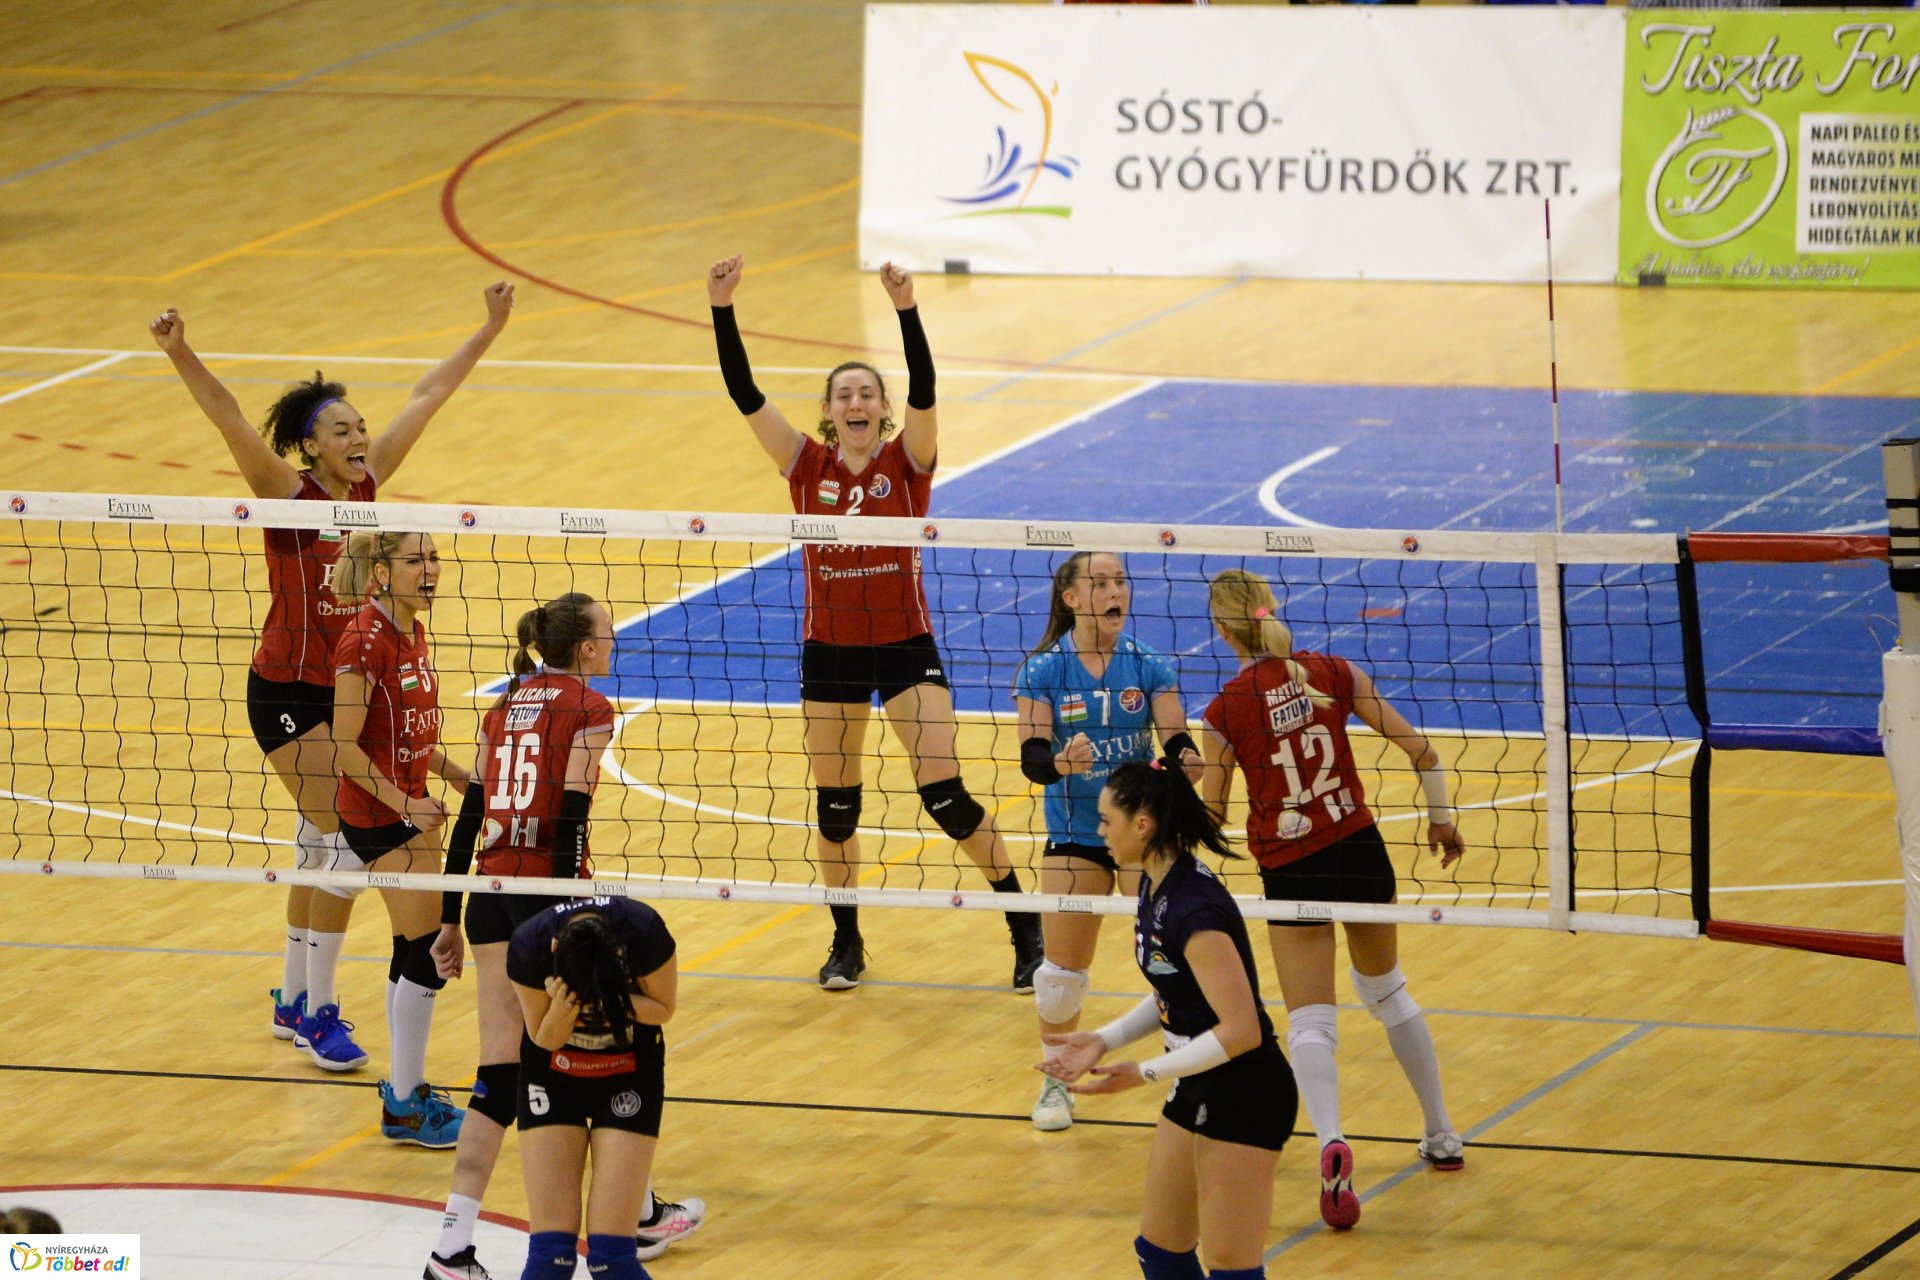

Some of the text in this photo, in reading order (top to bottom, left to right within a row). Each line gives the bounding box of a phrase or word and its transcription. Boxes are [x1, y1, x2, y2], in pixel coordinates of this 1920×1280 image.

[1641, 23, 1803, 104] Tiszta
[1116, 89, 1284, 136] SÓSTÓ-
[1810, 123, 1849, 142] NAPI
[1852, 123, 1900, 142] PALEO
[1811, 148, 1896, 168] MAGYAROS
[1485, 159, 1579, 197] ZRT.
[1807, 226, 1901, 245] HIDEGTÁLAK
[108, 498, 152, 513] FATUM
[846, 485, 864, 516] 2
[332, 505, 378, 521] FATUM
[560, 512, 605, 527] FATUM
[791, 519, 837, 534] FATUM
[1026, 525, 1073, 541] FATUM
[1265, 531, 1314, 546] FATUM
[1092, 687, 1111, 726] 7
[1272, 697, 1312, 728] FATUM
[280, 713, 296, 734] 3
[490, 732, 541, 811] 16
[1270, 724, 1342, 809] 12
[143, 865, 176, 877] FATUM
[367, 874, 400, 886] FATUM
[594, 881, 628, 894] FATUM
[824, 889, 858, 902] FATUM
[1059, 896, 1093, 909] FATUM
[1297, 903, 1333, 916] FATUM
[528, 1083, 550, 1116] 5
